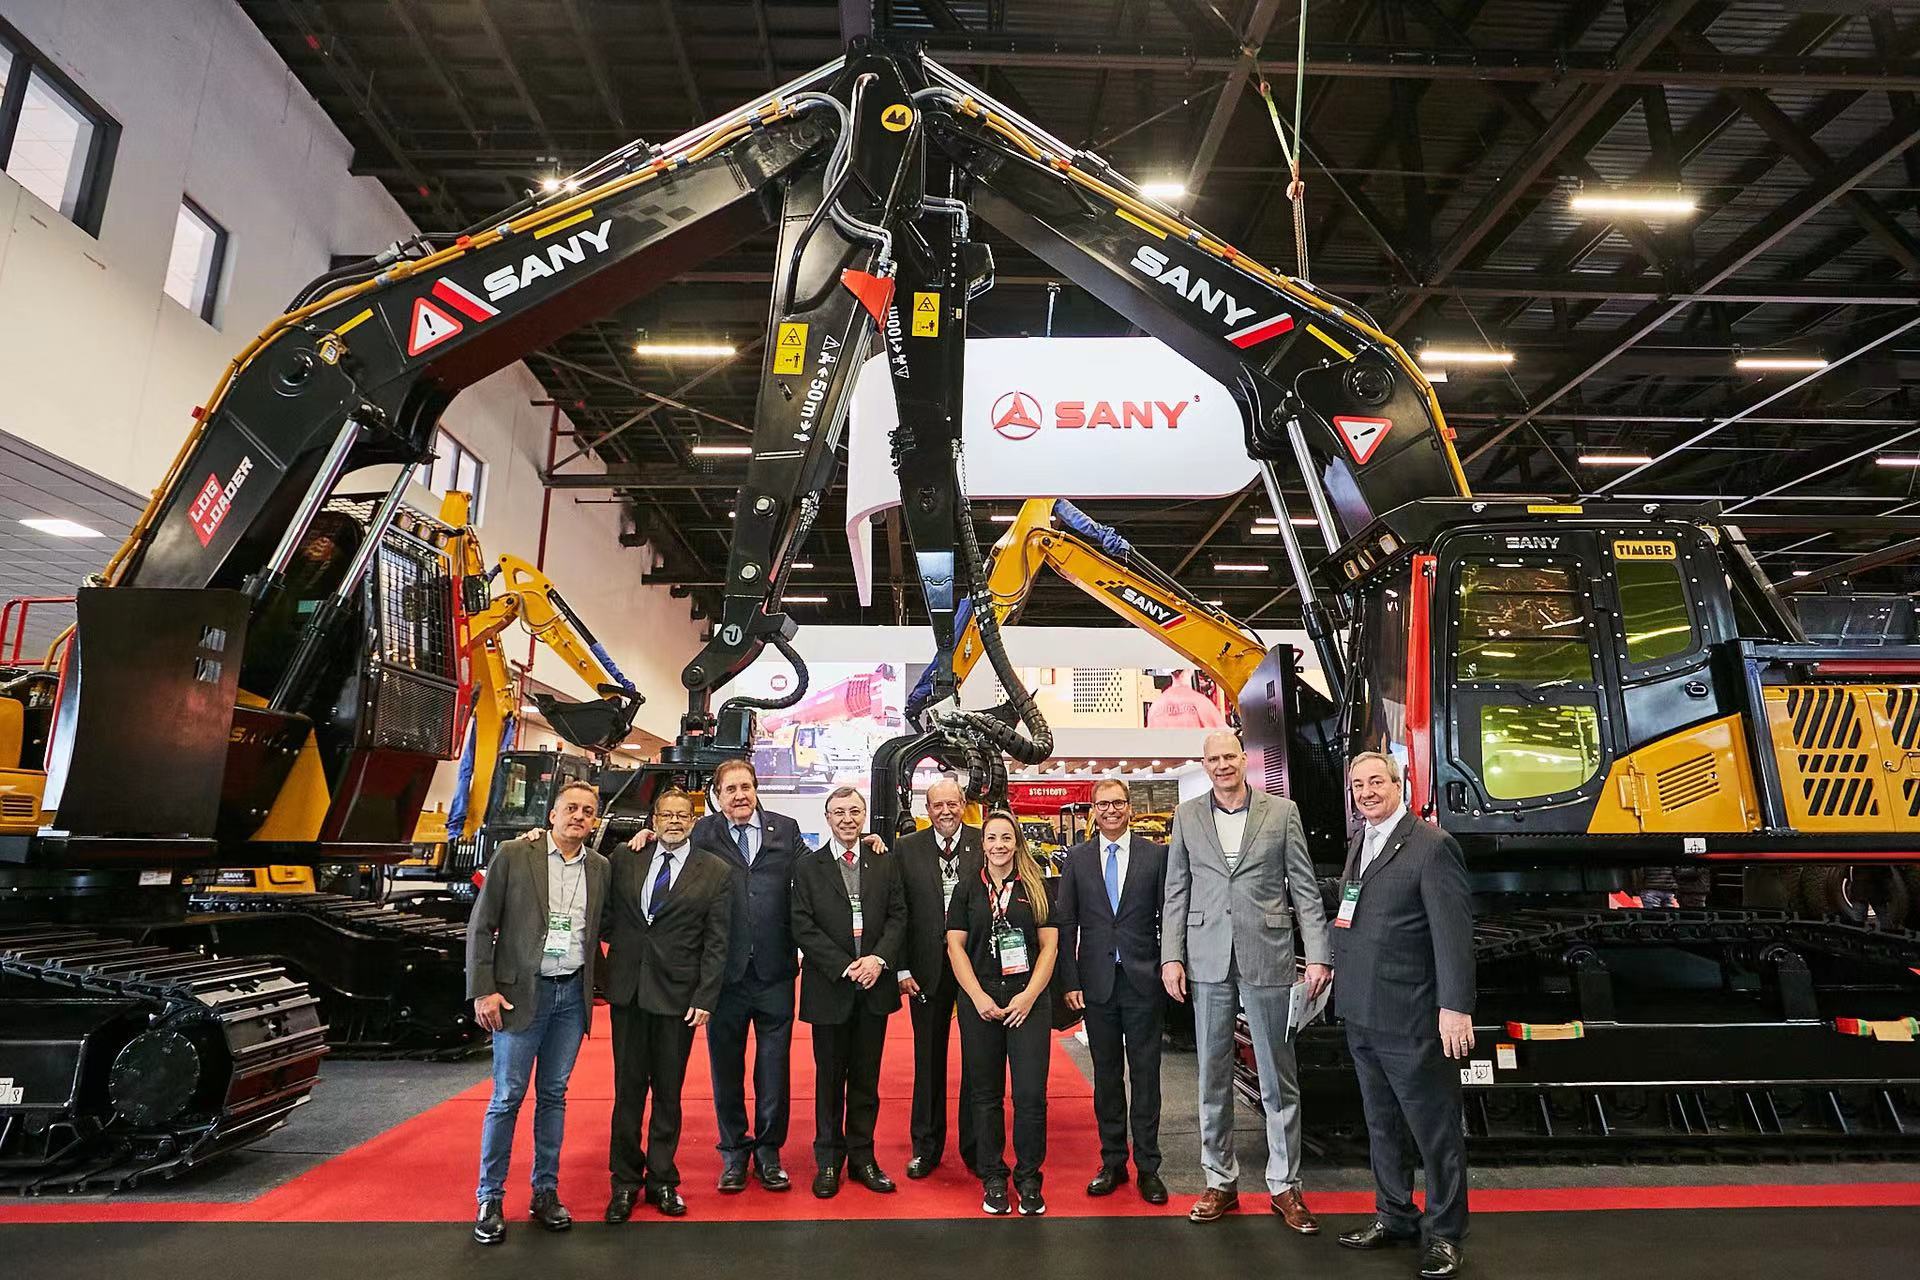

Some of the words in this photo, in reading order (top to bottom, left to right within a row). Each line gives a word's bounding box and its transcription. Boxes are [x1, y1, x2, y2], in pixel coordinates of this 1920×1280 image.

[483, 219, 612, 302] SANY
[1130, 245, 1257, 327] SANY
[886, 306, 903, 344] 100m
[800, 378, 828, 418] 50m
[1055, 401, 1189, 429] SANY
[190, 480, 219, 523] LOG
[202, 455, 254, 535] LOADER
[1505, 536, 1560, 549] SANY
[1617, 544, 1673, 556] TIMBER
[1121, 588, 1171, 621] SANY
